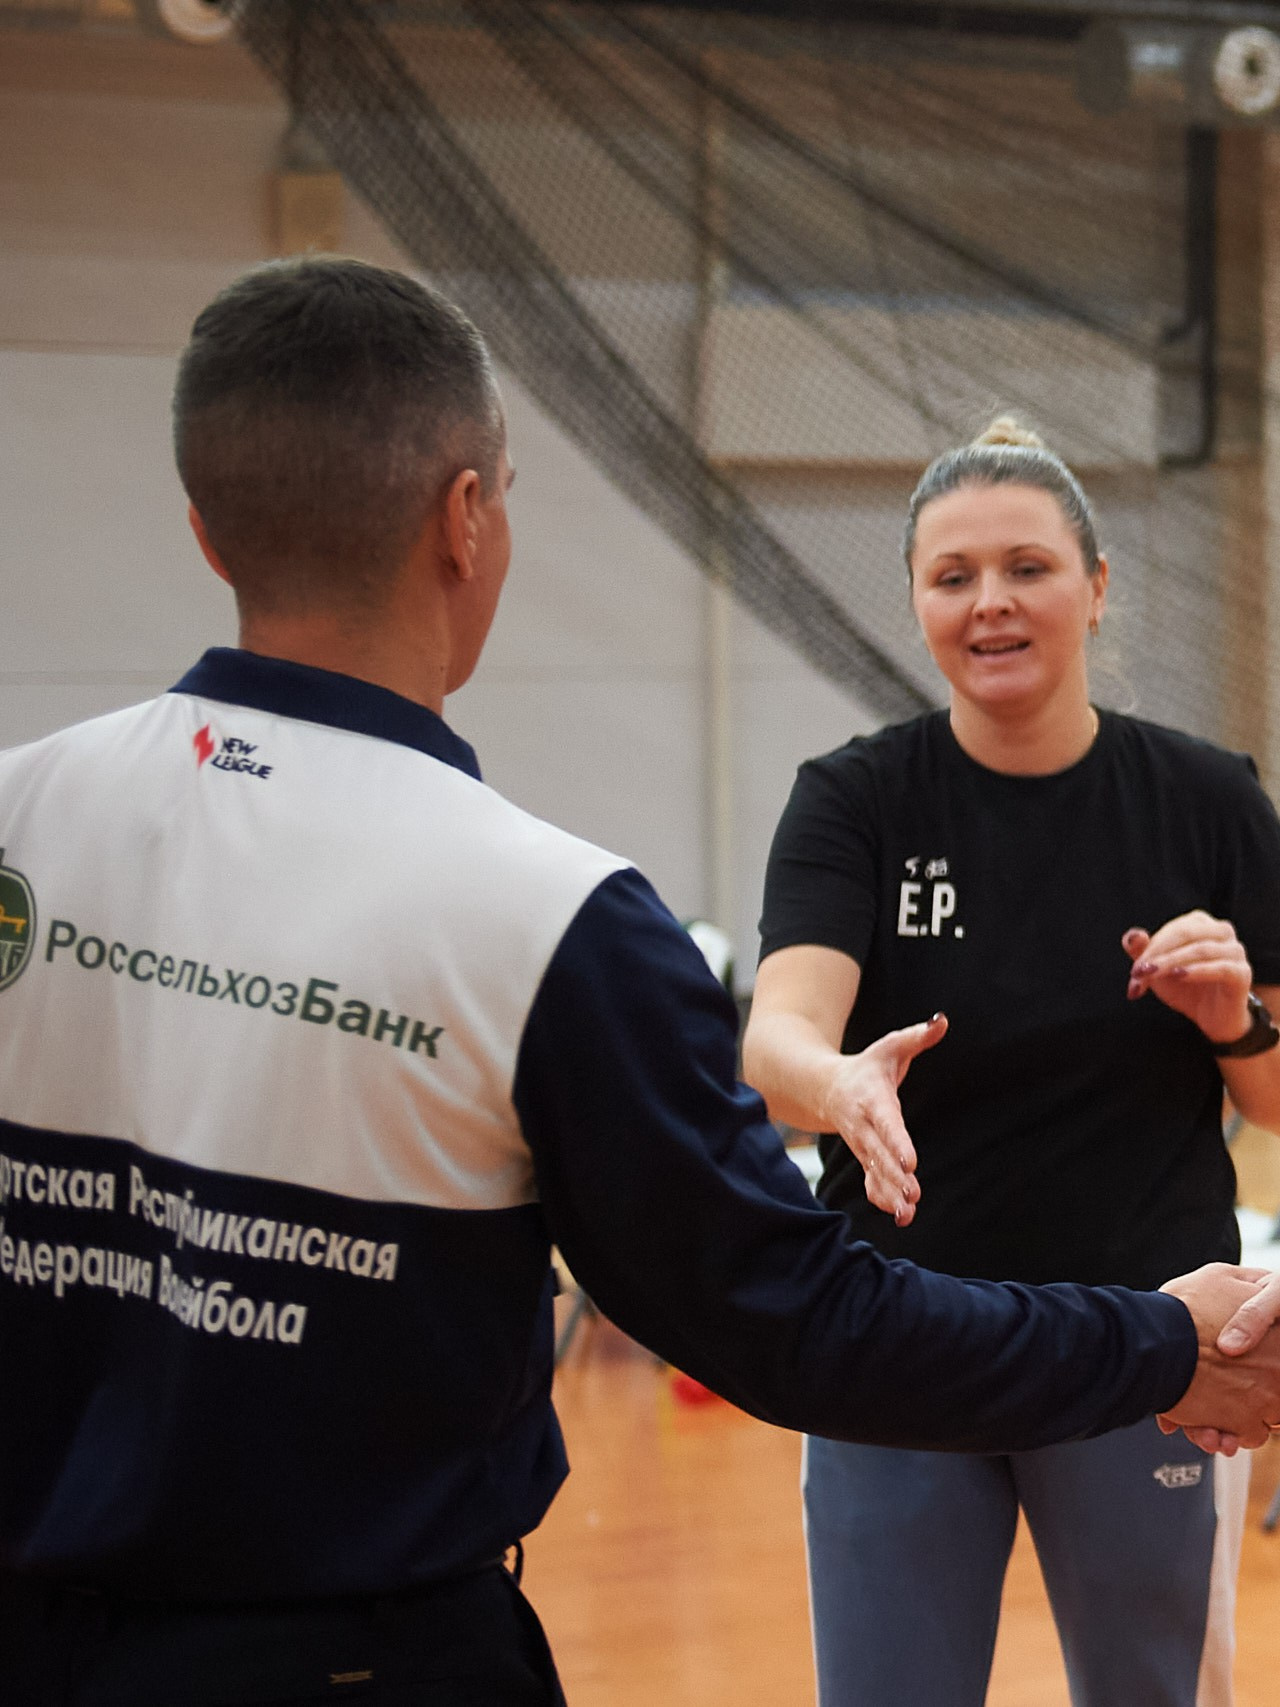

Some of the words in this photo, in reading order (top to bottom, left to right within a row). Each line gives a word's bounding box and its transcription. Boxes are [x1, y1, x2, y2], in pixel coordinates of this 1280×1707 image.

[45, 919, 445, 1059] РоссельхозБанк
[0, 1216, 153, 1298] едерация
[157, 1254, 308, 1344] Вйбола
